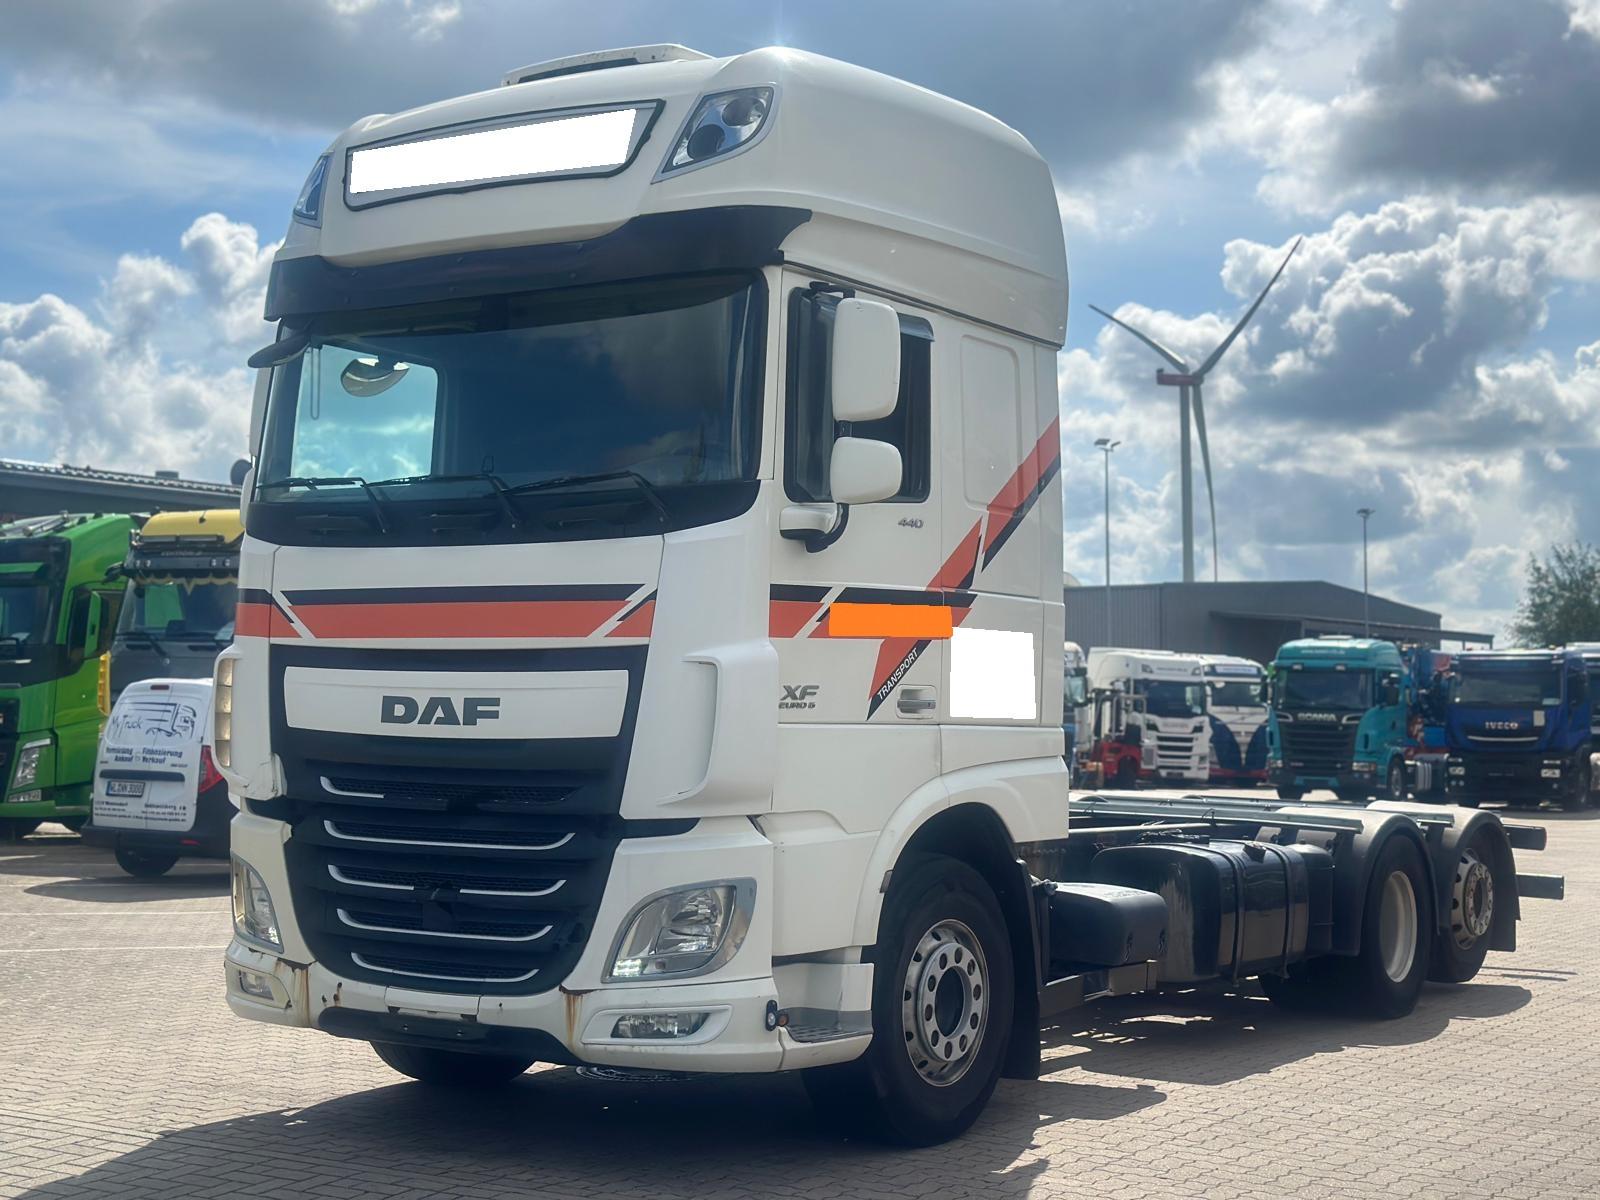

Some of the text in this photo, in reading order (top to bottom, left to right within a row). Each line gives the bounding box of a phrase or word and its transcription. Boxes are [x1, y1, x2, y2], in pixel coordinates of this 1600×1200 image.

[897, 517, 924, 529] 440
[876, 647, 919, 700] TRANSPORT
[779, 685, 820, 701] XF
[380, 695, 501, 726] DAF
[1297, 712, 1337, 722] SCANIA
[1485, 721, 1519, 730] IVECO
[142, 756, 166, 764] Verkauf
